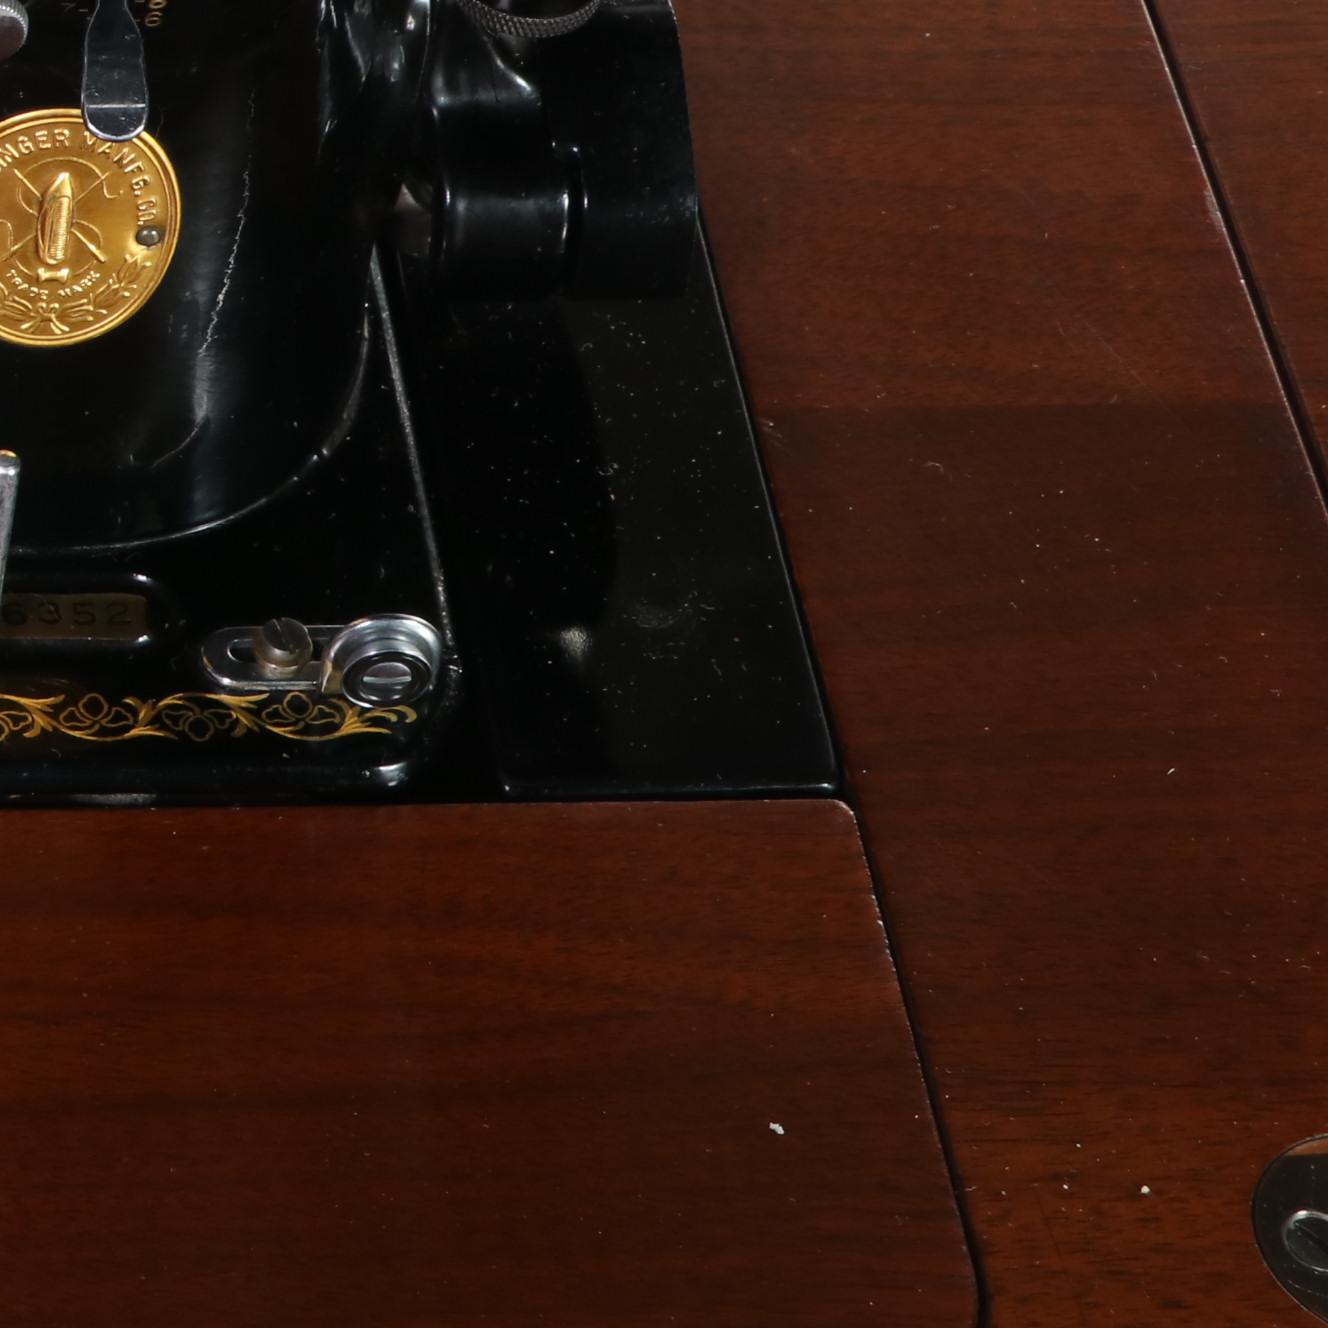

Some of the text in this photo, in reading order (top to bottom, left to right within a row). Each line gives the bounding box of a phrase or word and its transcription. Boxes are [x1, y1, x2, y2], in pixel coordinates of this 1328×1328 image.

[144, 12, 162, 28] 6
[5, 268, 101, 300] TRADE MARK
